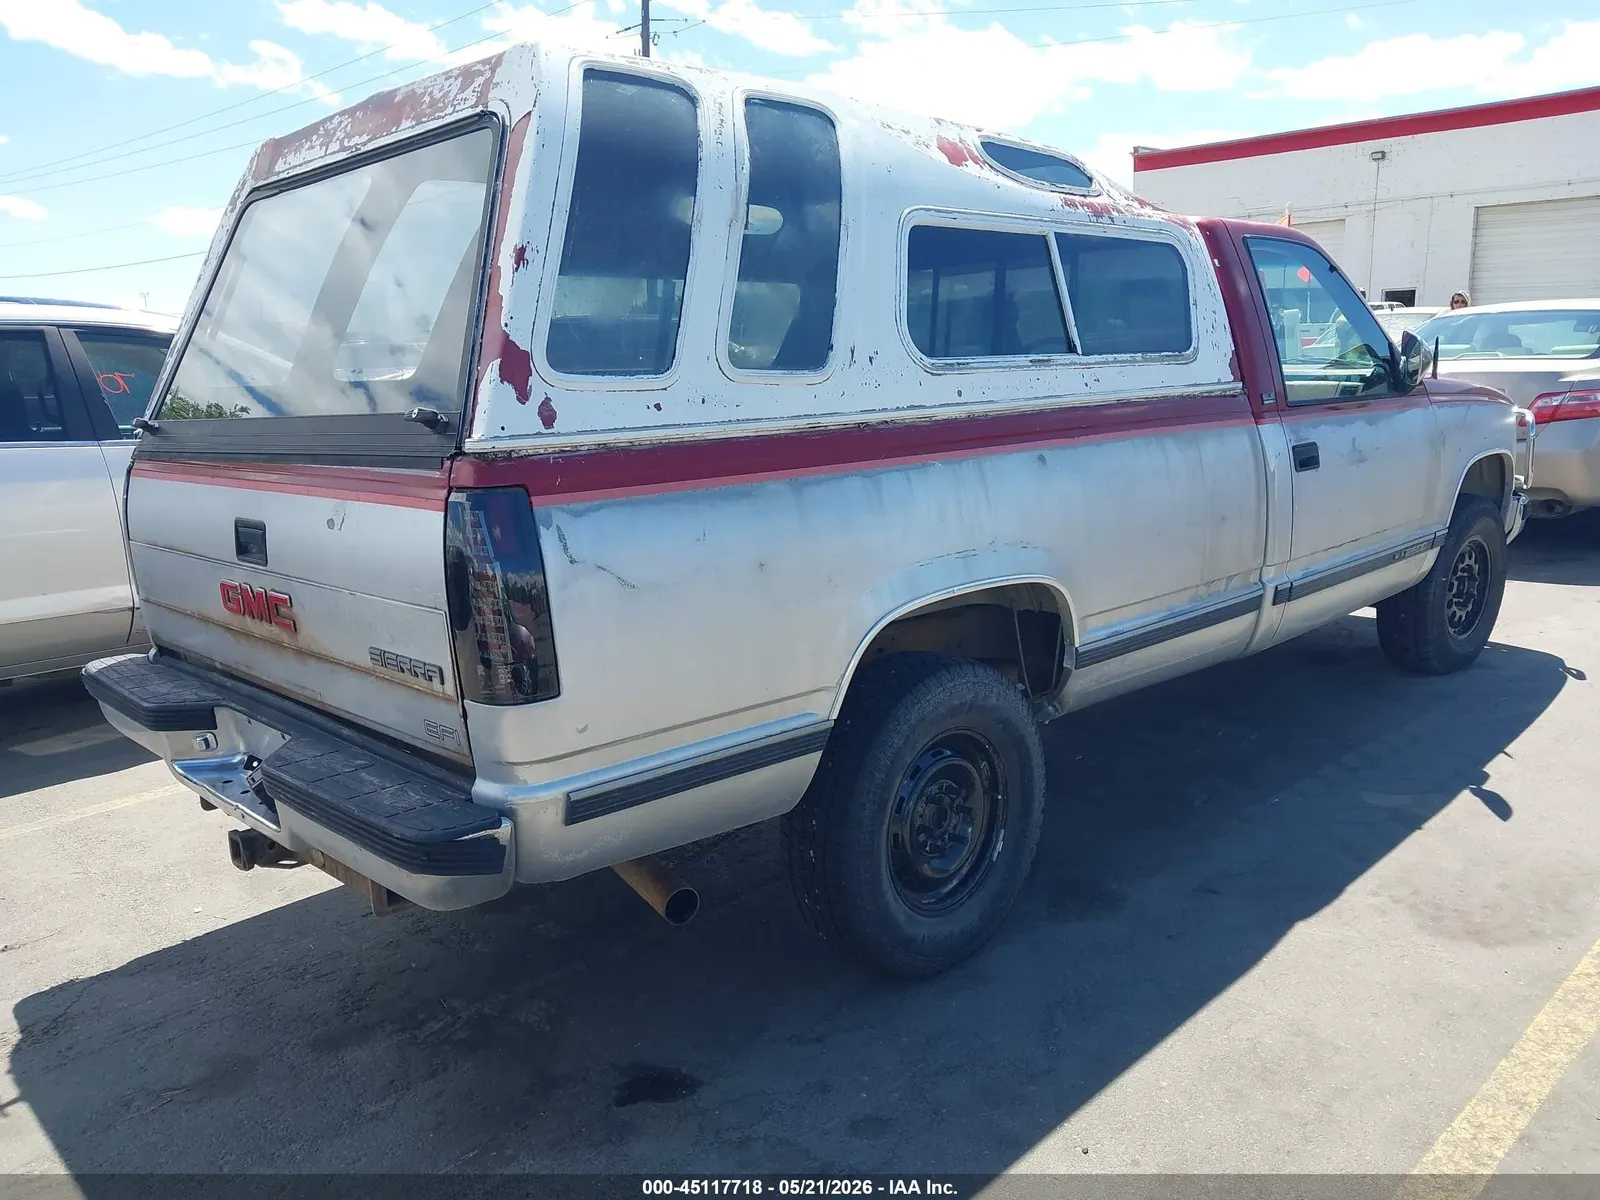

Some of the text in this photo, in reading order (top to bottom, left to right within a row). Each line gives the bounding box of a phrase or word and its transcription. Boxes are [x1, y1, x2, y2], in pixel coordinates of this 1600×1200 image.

[219, 578, 297, 632] GMC
[368, 646, 445, 686] SIERRA
[423, 718, 461, 747] EFI
